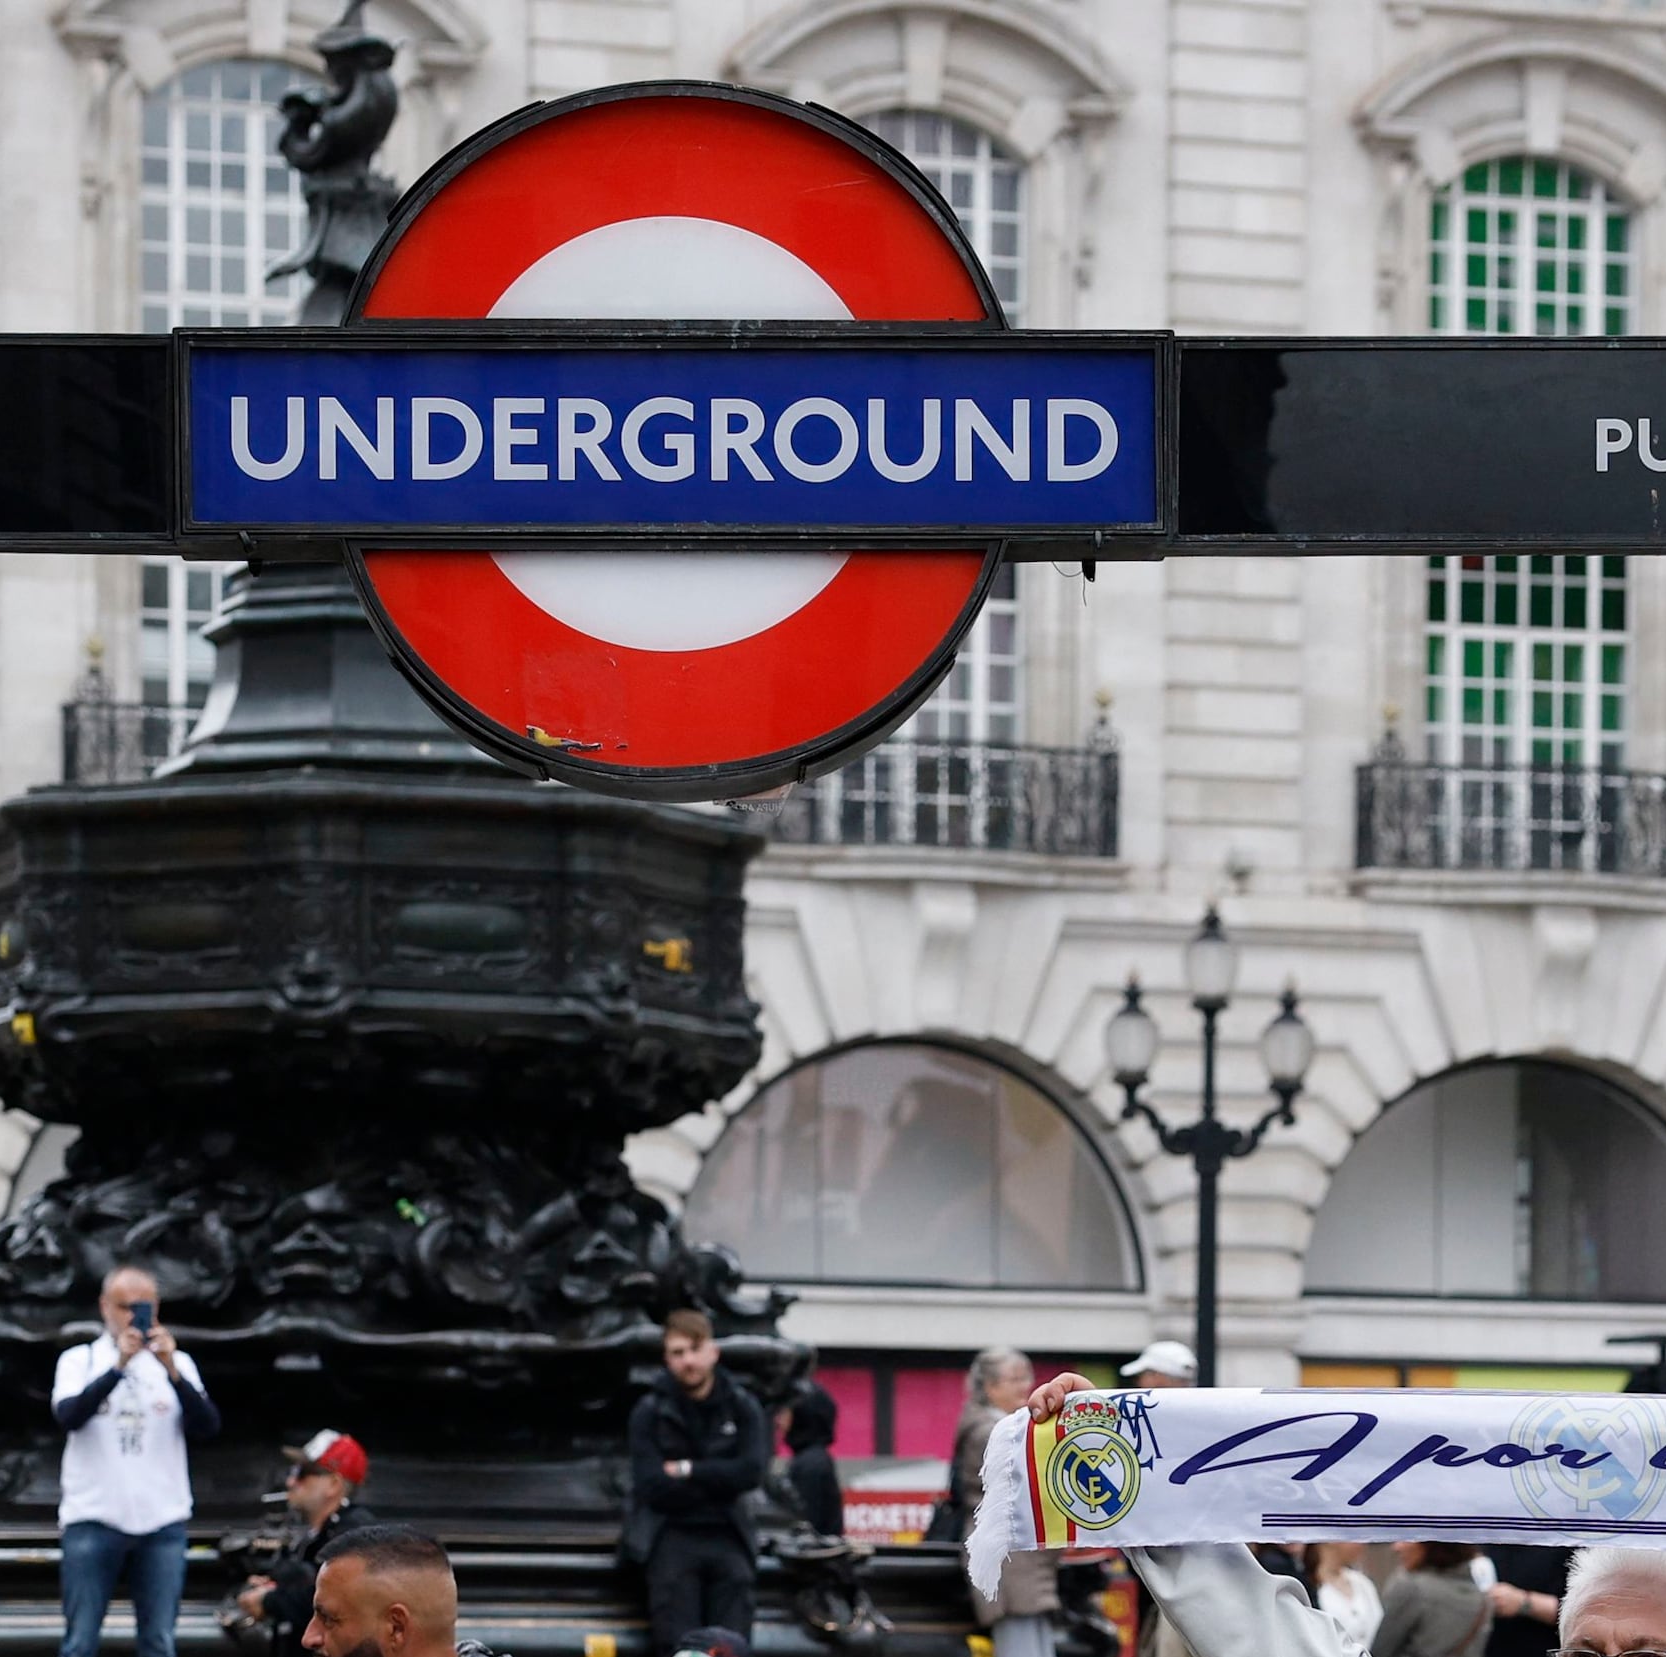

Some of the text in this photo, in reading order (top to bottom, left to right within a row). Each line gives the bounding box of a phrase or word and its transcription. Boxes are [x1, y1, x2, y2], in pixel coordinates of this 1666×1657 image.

[231, 396, 1118, 483] UNDERGROUND
[1168, 1411, 1379, 1485] A
[1347, 1434, 1611, 1506] por
